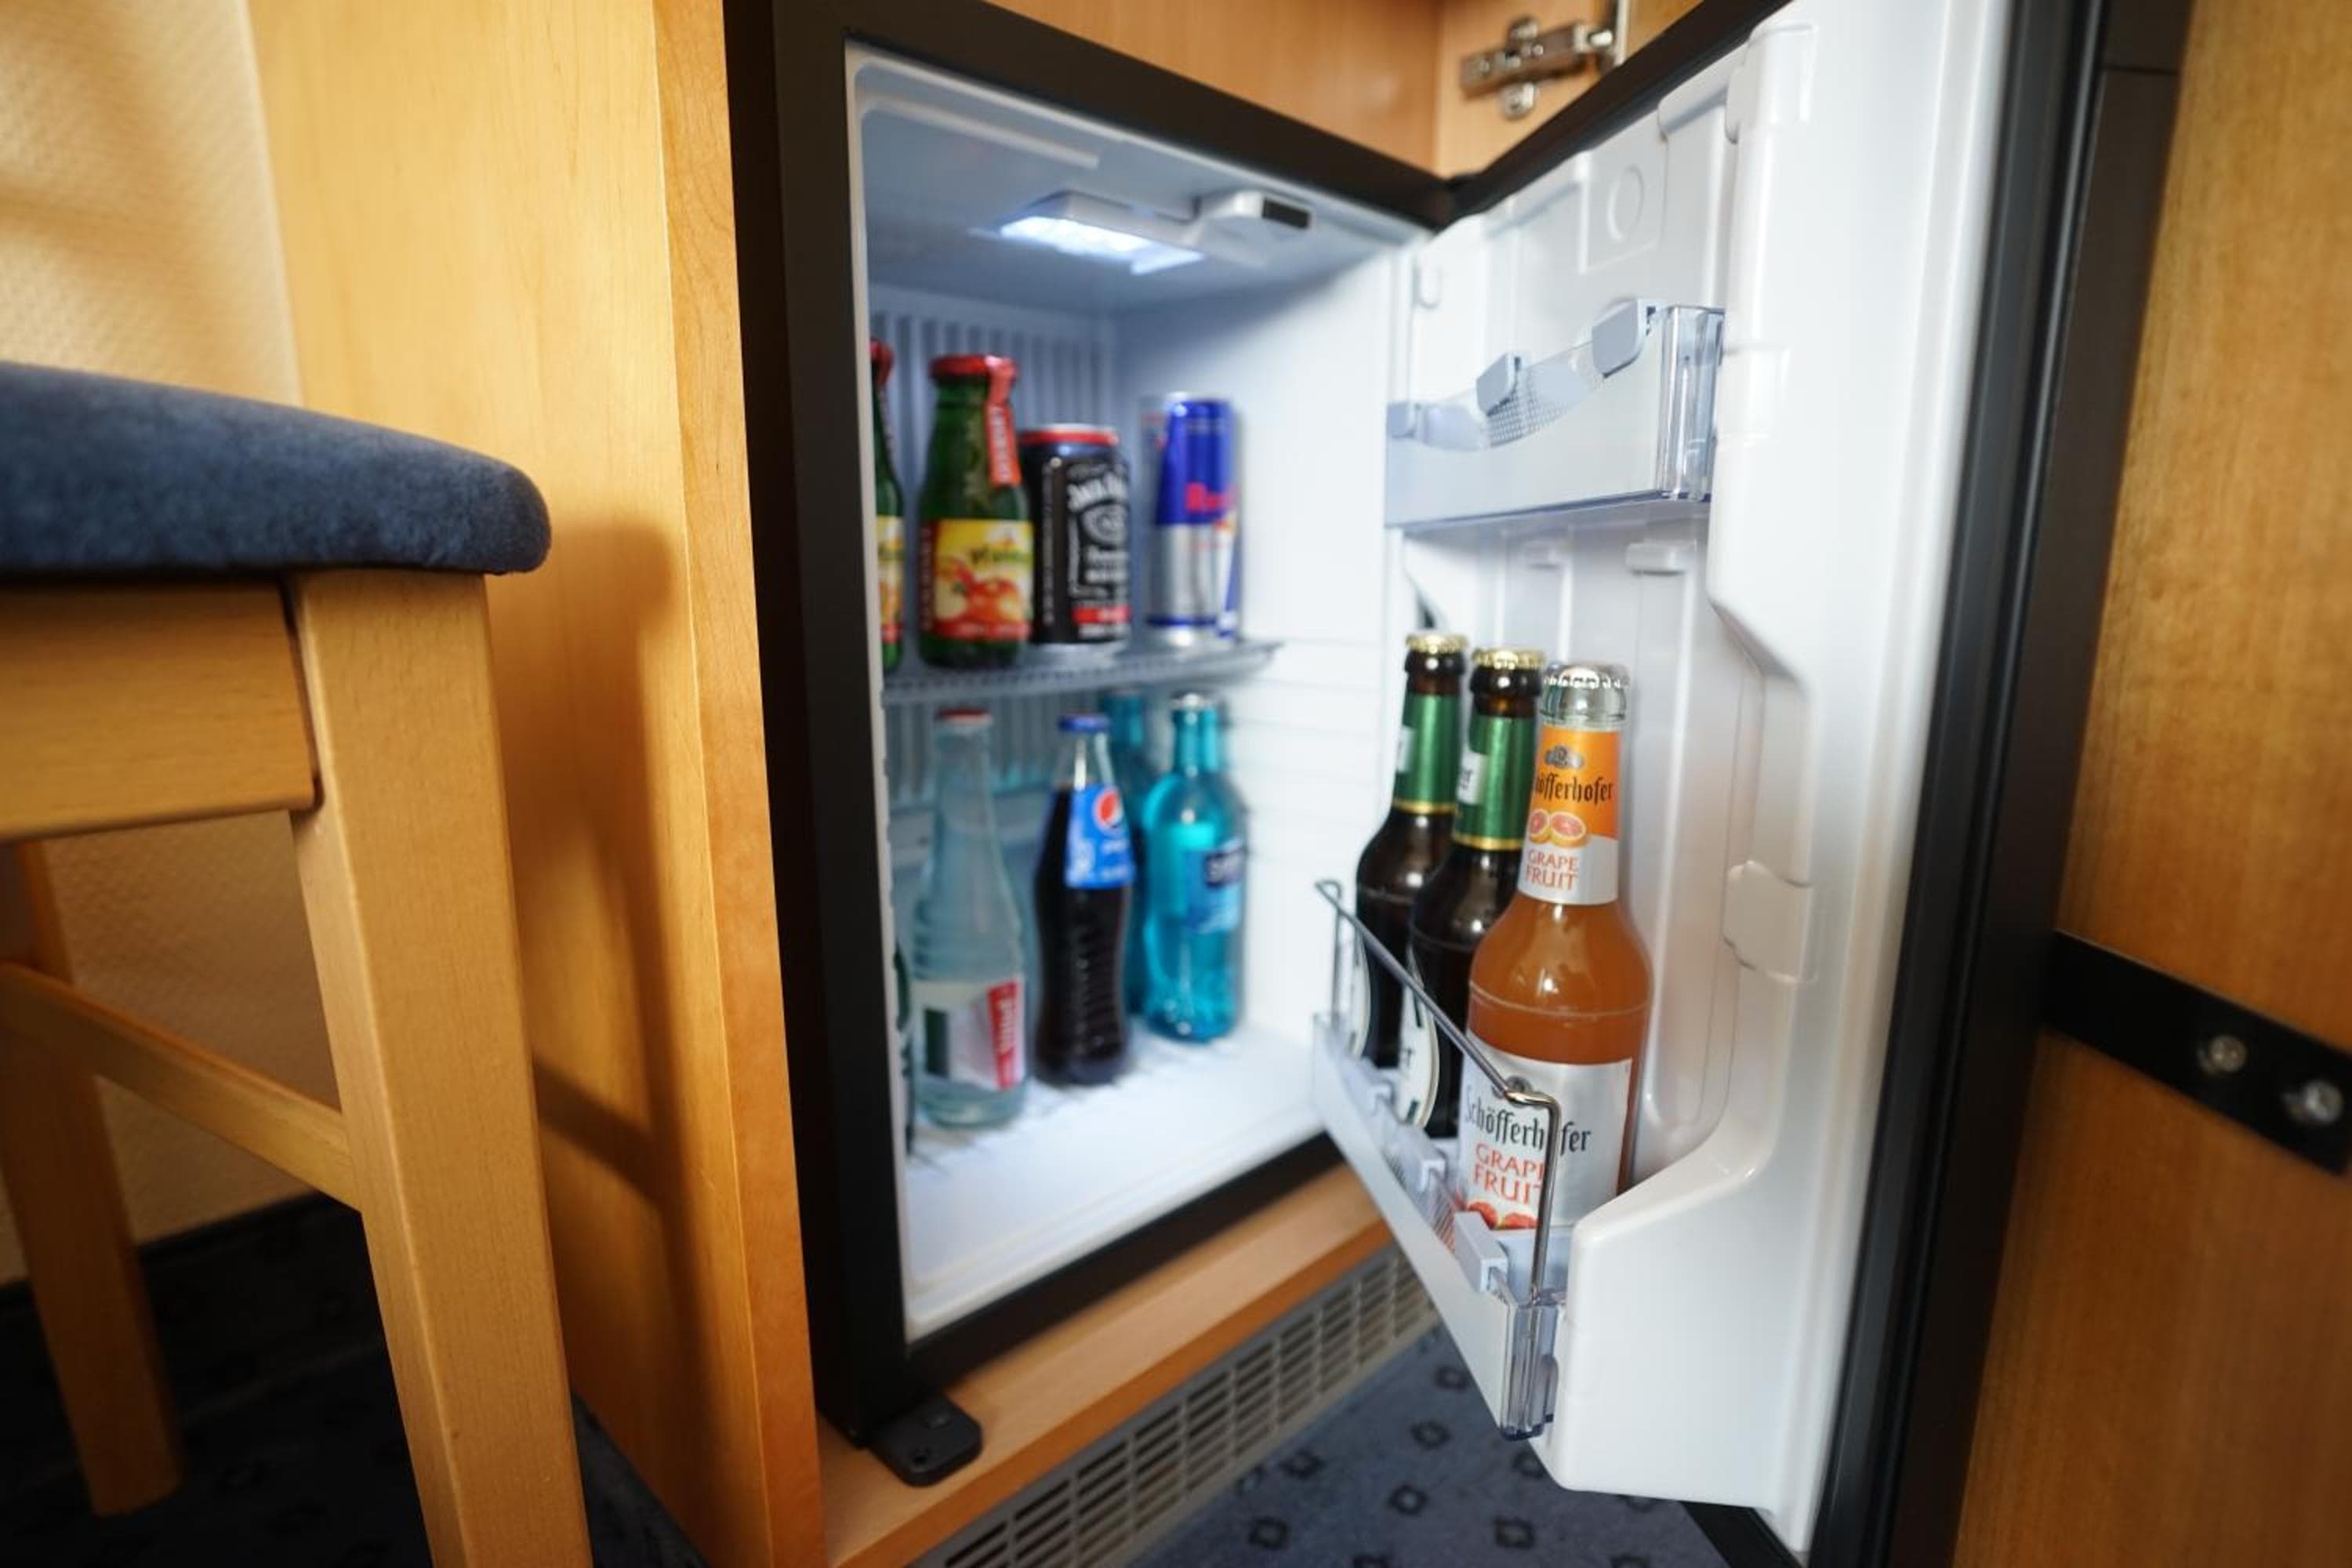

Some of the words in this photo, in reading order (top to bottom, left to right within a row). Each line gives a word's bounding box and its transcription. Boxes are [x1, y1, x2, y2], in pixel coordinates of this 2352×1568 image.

[1529, 849, 1579, 871] GRAPE
[1526, 865, 1578, 891] FRUIT
[1465, 1085, 1591, 1156] Schöfferhfer
